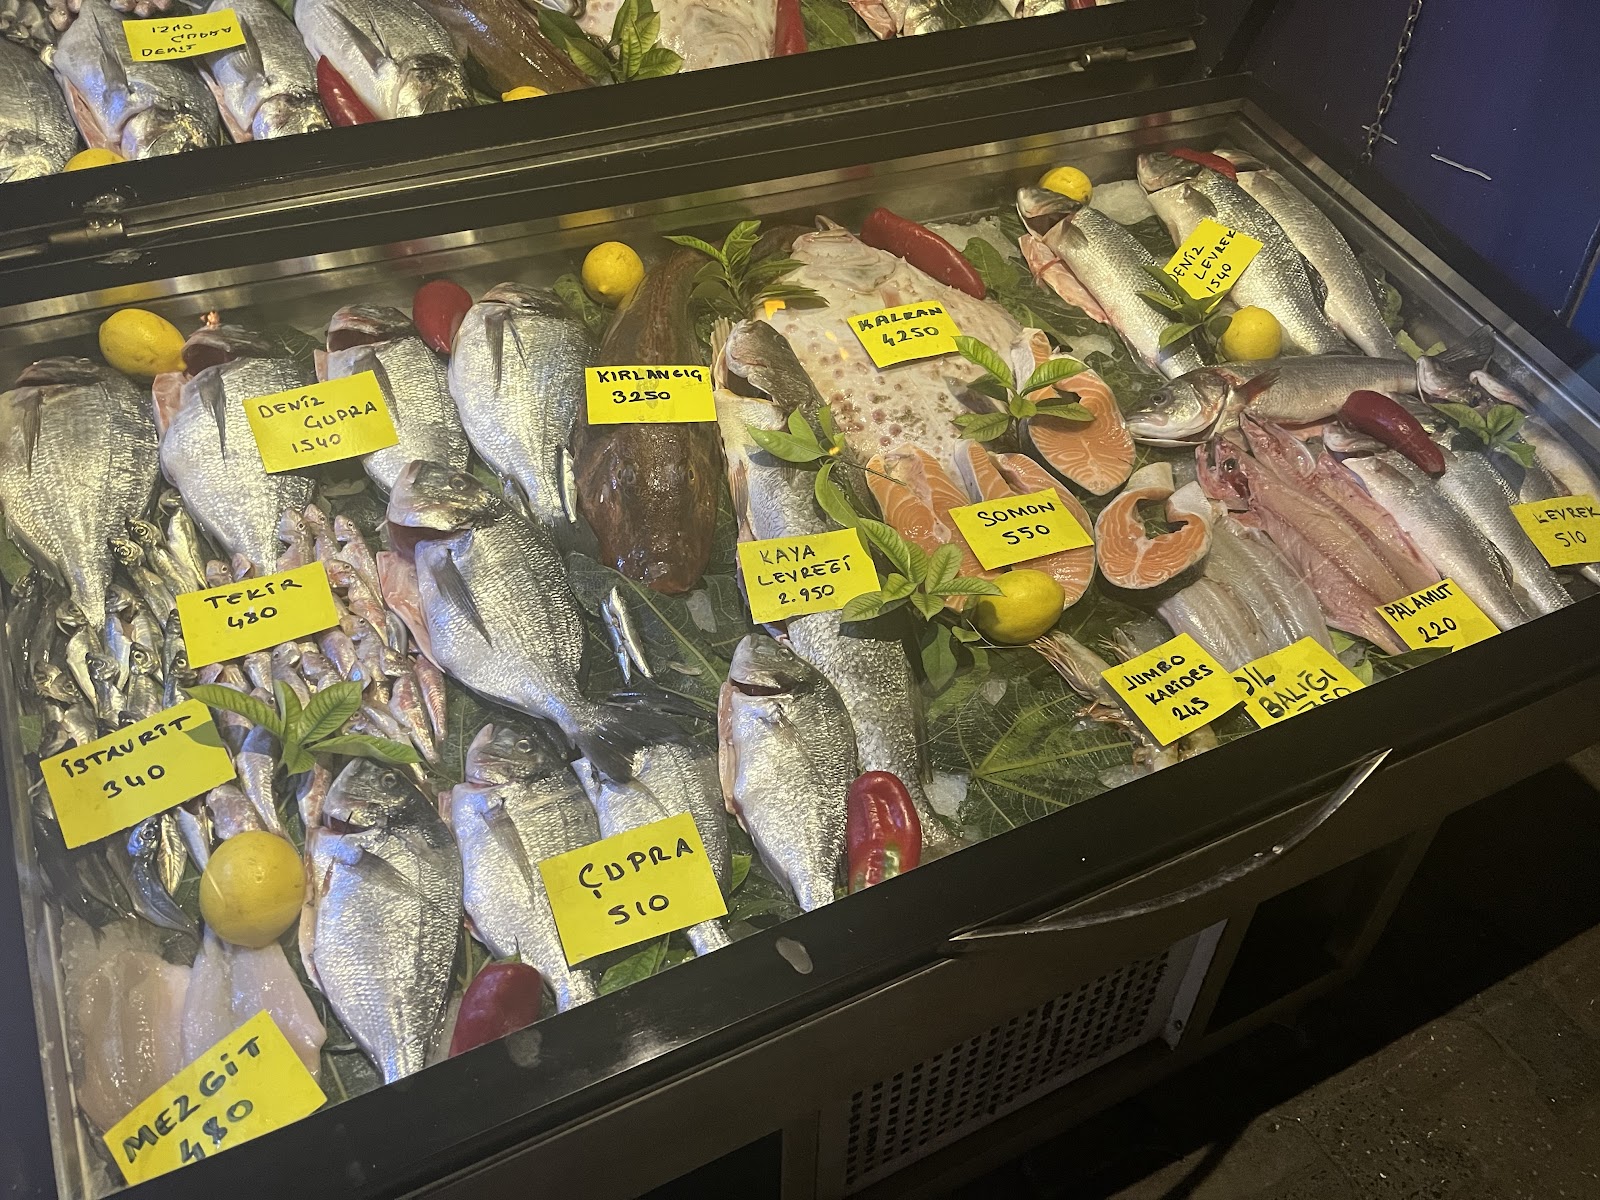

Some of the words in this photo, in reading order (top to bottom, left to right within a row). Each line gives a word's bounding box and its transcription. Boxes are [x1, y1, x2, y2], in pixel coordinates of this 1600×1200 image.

[1193, 229, 1237, 280] LEVREK
[1205, 263, 1232, 294] 1540
[857, 306, 943, 332] KALKAN
[882, 326, 940, 347] 4250
[612, 390, 671, 404] 3250
[977, 501, 1056, 527] SOMON
[1532, 506, 1600, 524] LEVREK
[1001, 524, 1051, 545] 550
[1554, 530, 1587, 548] 510
[759, 545, 816, 565] KAYA
[203, 578, 303, 609] TEKİR
[778, 584, 835, 605] 2.950
[1383, 583, 1454, 622] PALAMUT
[227, 606, 278, 630] 480
[1417, 617, 1457, 643] 220
[1123, 655, 1186, 692] JUMBO
[1171, 696, 1210, 721] 245
[102, 764, 166, 799] 340
[578, 837, 694, 900] ÇUPRA
[607, 894, 670, 926] 510
[122, 1035, 261, 1164] MEZGİT
[179, 1099, 254, 1164] 480
